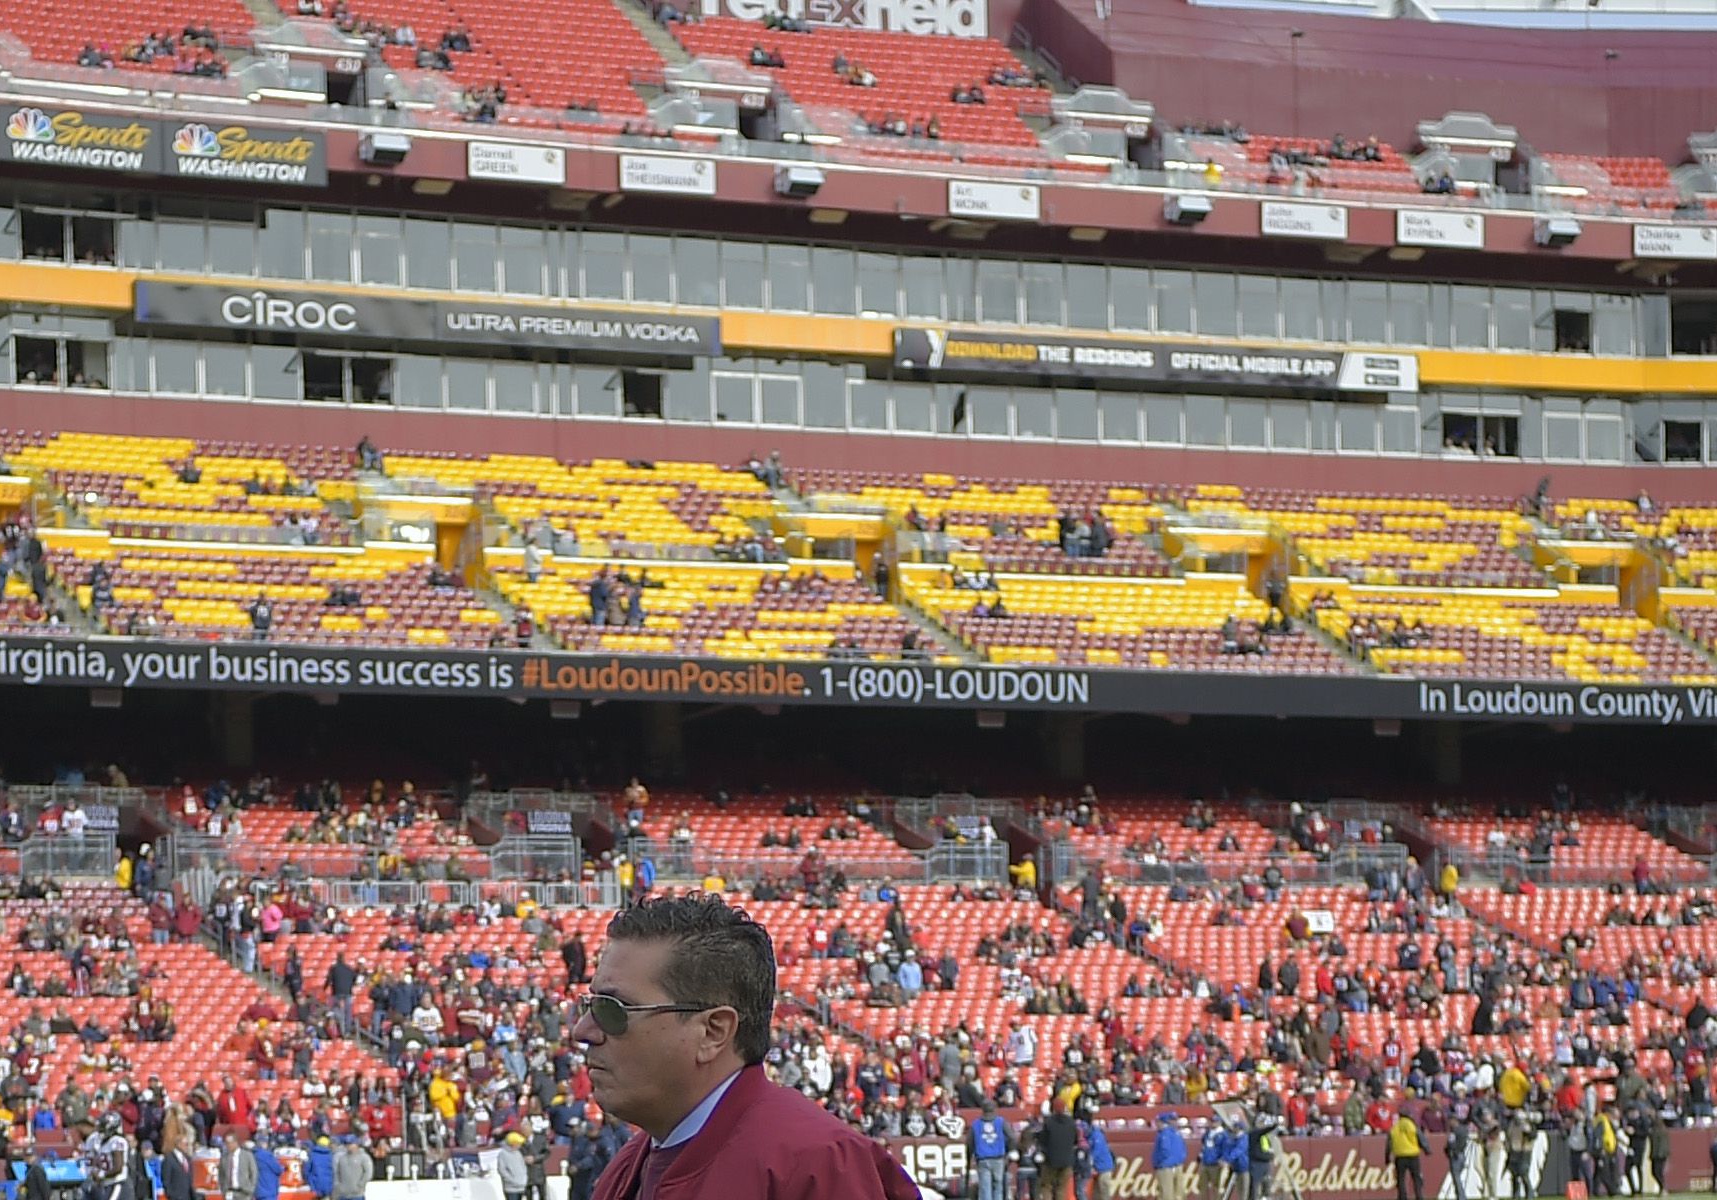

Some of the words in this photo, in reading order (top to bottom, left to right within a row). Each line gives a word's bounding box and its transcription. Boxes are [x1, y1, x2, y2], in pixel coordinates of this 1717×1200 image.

[50, 111, 152, 150] Sports
[216, 126, 316, 162] Sports
[11, 140, 143, 169] WASHINGTON
[177, 157, 306, 183] WASHINGTON
[220, 291, 357, 332] CÎROC
[446, 311, 513, 333] ULTRA
[519, 316, 622, 337] PREMIUM
[625, 323, 699, 344] VODKA
[1038, 345, 1071, 364] THE
[1303, 360, 1336, 377] APP
[123, 650, 202, 684] your
[209, 646, 352, 686] business
[358, 656, 482, 689] success
[487, 656, 514, 689] is
[521, 660, 811, 699] #LoudounPossible.
[819, 668, 1089, 705] 1-(800)-LOUDOUN
[1420, 683, 1449, 715] In
[1455, 683, 1574, 717] Loudoun
[1579, 686, 1684, 725] County,
[1271, 1149, 1397, 1194] Redskins
